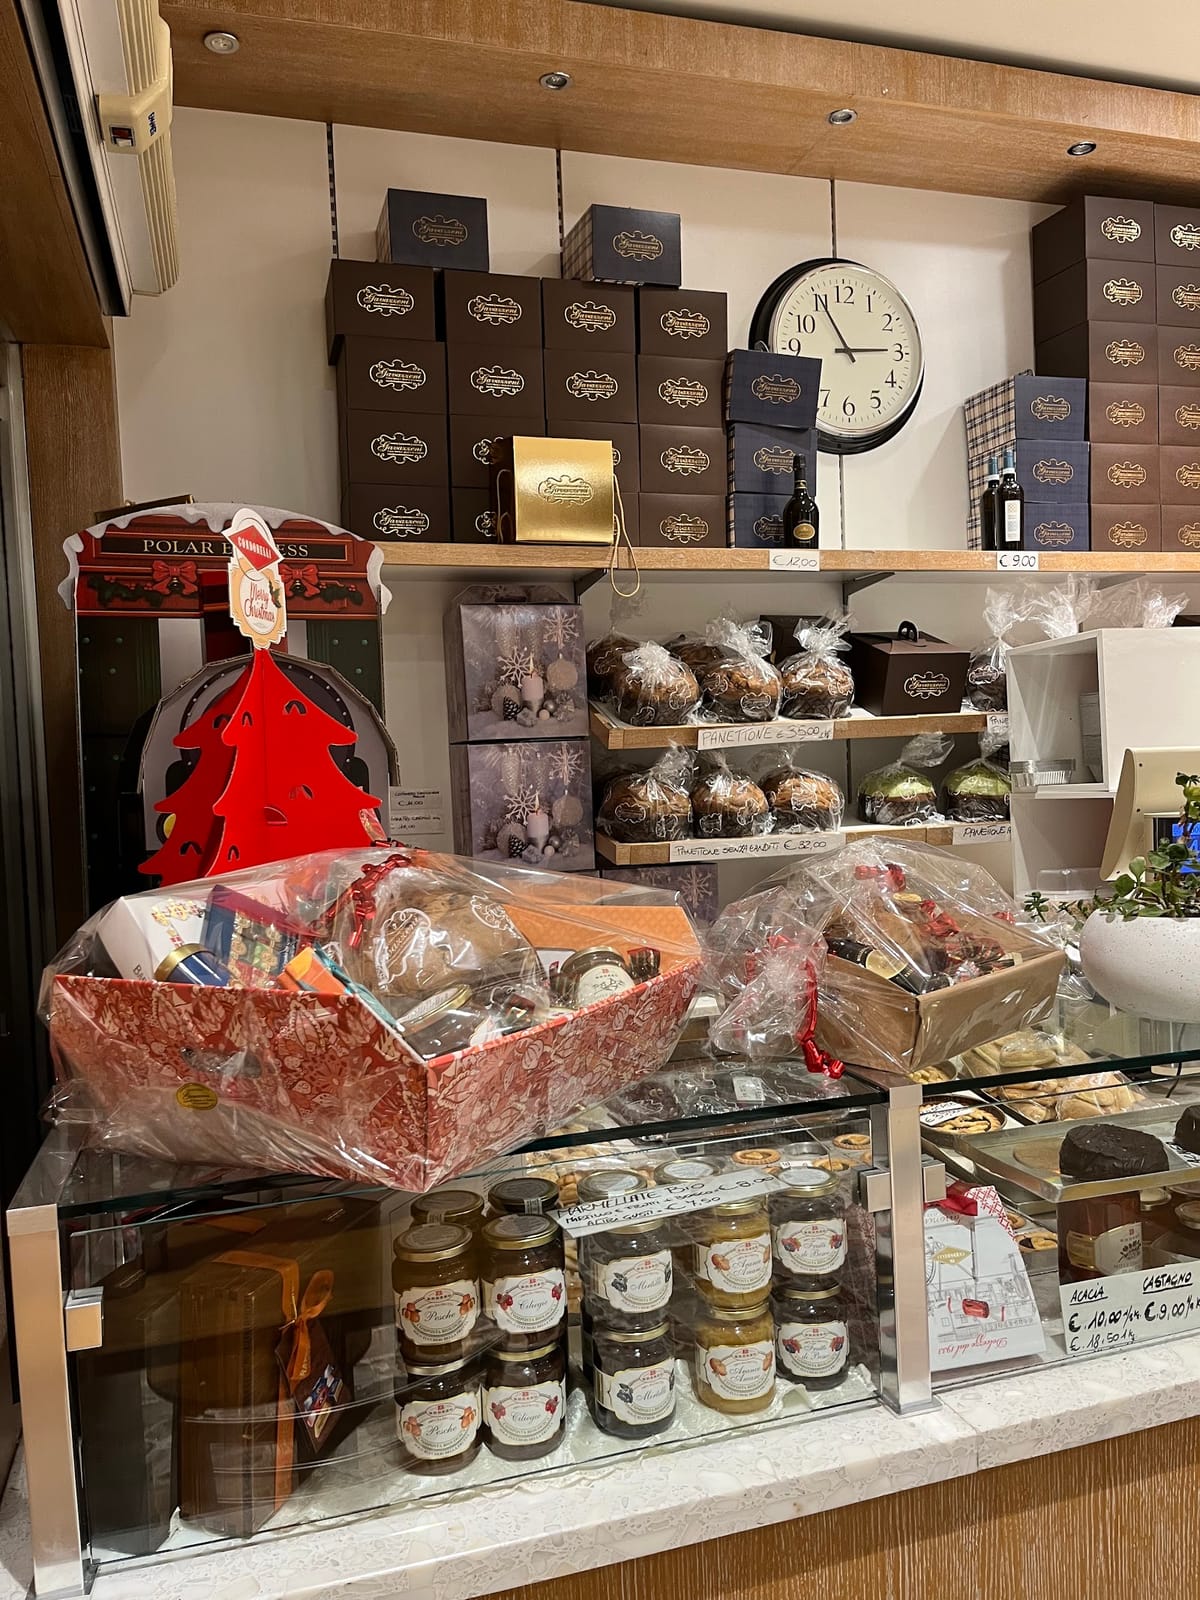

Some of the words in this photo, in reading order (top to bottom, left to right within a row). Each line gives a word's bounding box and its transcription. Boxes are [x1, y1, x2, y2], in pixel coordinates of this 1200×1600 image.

[814, 294, 828, 312] 11
[834, 285, 855, 304] 12
[866, 295, 873, 313] 1
[796, 314, 816, 334] 10
[882, 313, 893, 332] 2
[788, 338, 801, 357] 9
[894, 343, 904, 361] 3
[885, 370, 897, 388] 4
[820, 389, 831, 408] 7
[842, 399, 856, 416] 6
[870, 390, 881, 409] 5
[143, 539, 215, 555] POLAR
[222, 541, 309, 557] EESS
[237, 536, 272, 559] CONDORELLI
[250, 582, 269, 609] Merry
[244, 598, 275, 623] Christmas
[702, 726, 773, 746] PANETTONE
[558, 1191, 660, 1219] MARMELLATE
[665, 1182, 705, 1195] BIO
[1143, 1271, 1192, 1292] CASTAGNO
[1070, 1282, 1104, 1303] ACACIA
[424, 1309, 456, 1322] Pesche
[425, 1423, 458, 1436] Pesche
